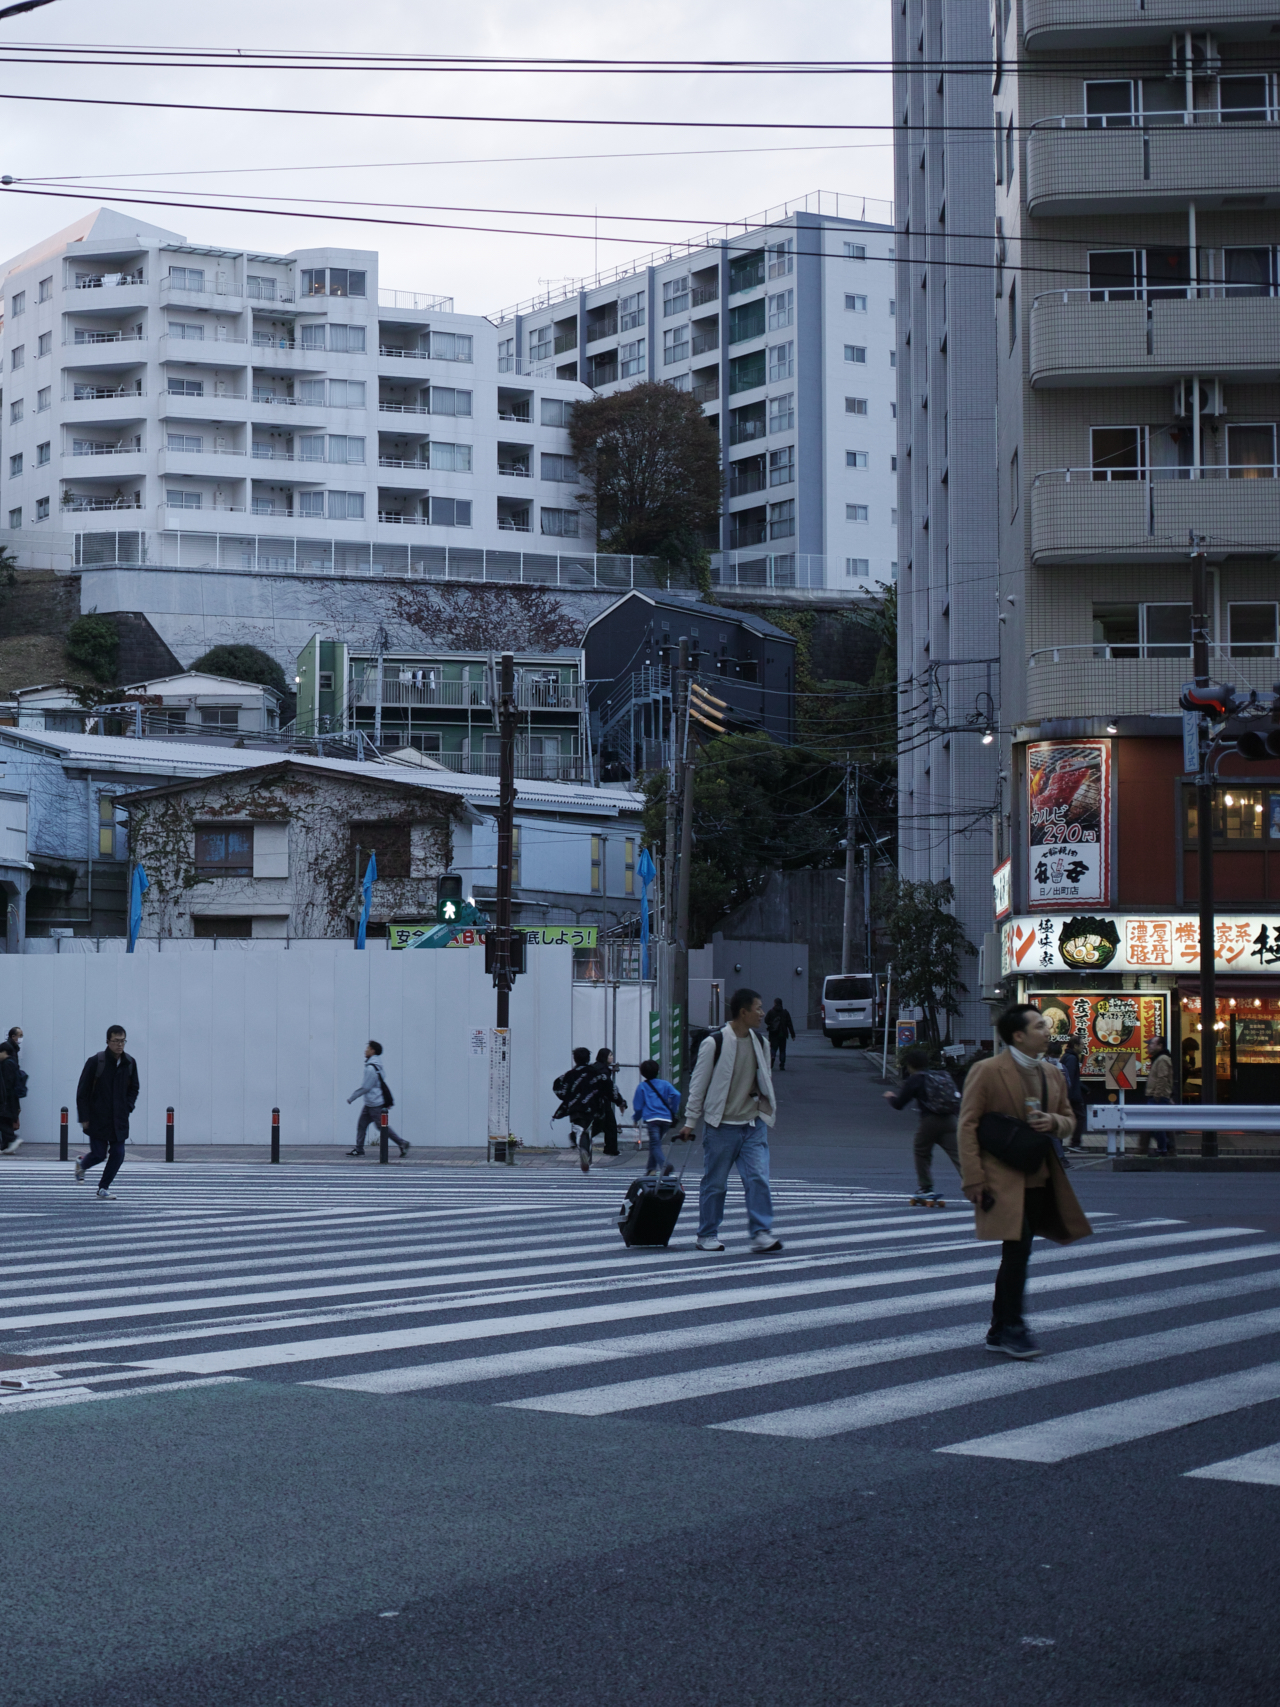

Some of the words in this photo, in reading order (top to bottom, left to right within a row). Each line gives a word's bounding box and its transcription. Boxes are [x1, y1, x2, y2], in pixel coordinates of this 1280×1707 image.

[1031, 804, 1070, 827] カルビ
[1043, 822, 1098, 845] 290円
[1039, 886, 1080, 896] 日ノ出町店
[1175, 922, 1252, 944] 横家系
[1180, 944, 1246, 965] ラメン
